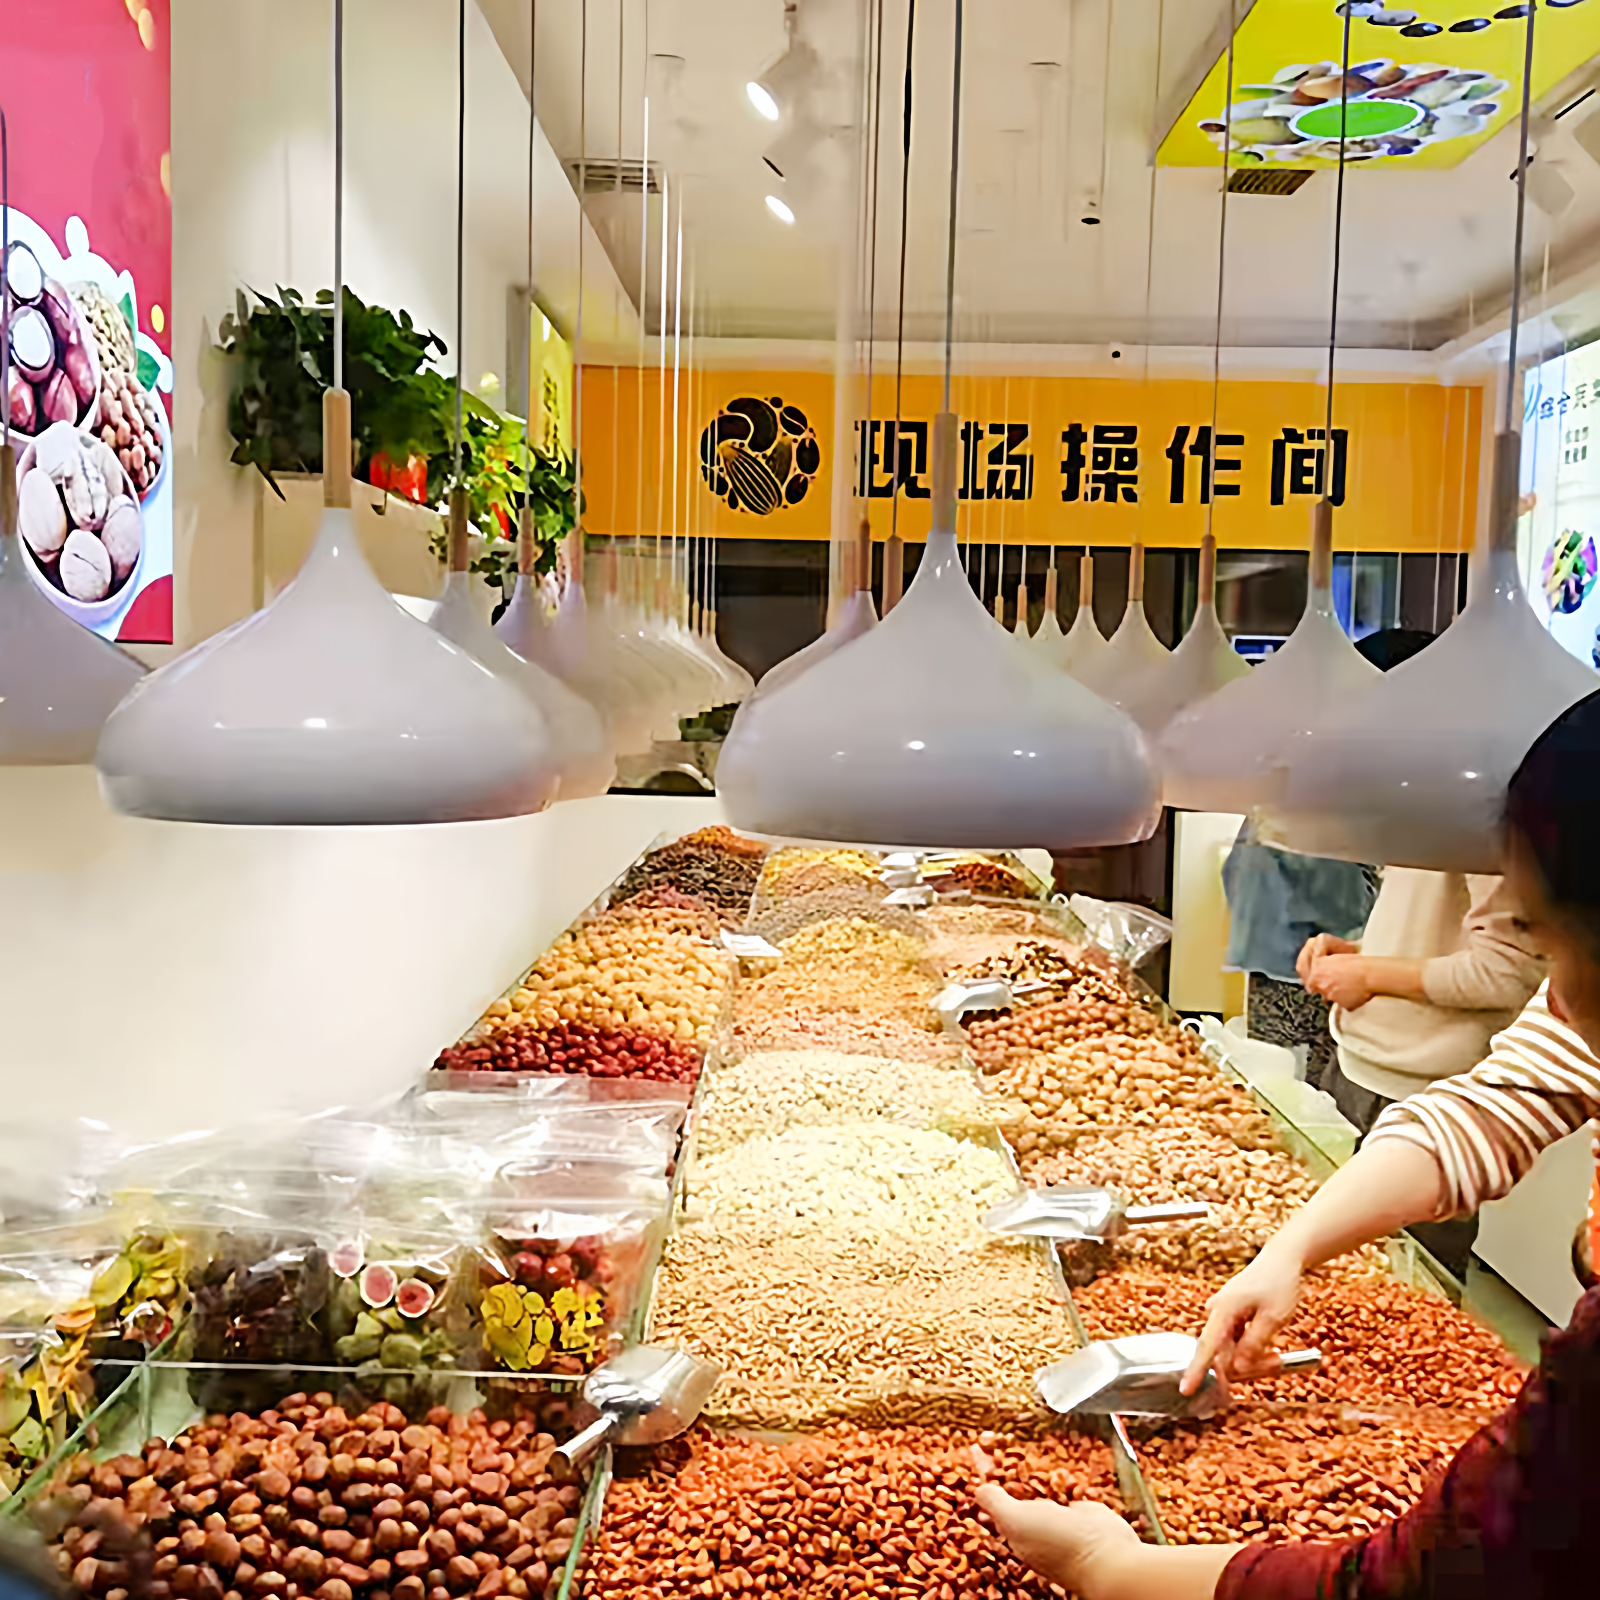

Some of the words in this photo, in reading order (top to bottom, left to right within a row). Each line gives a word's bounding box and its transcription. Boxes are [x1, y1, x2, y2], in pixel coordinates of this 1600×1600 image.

[854, 420, 1348, 506] 现场操作间
